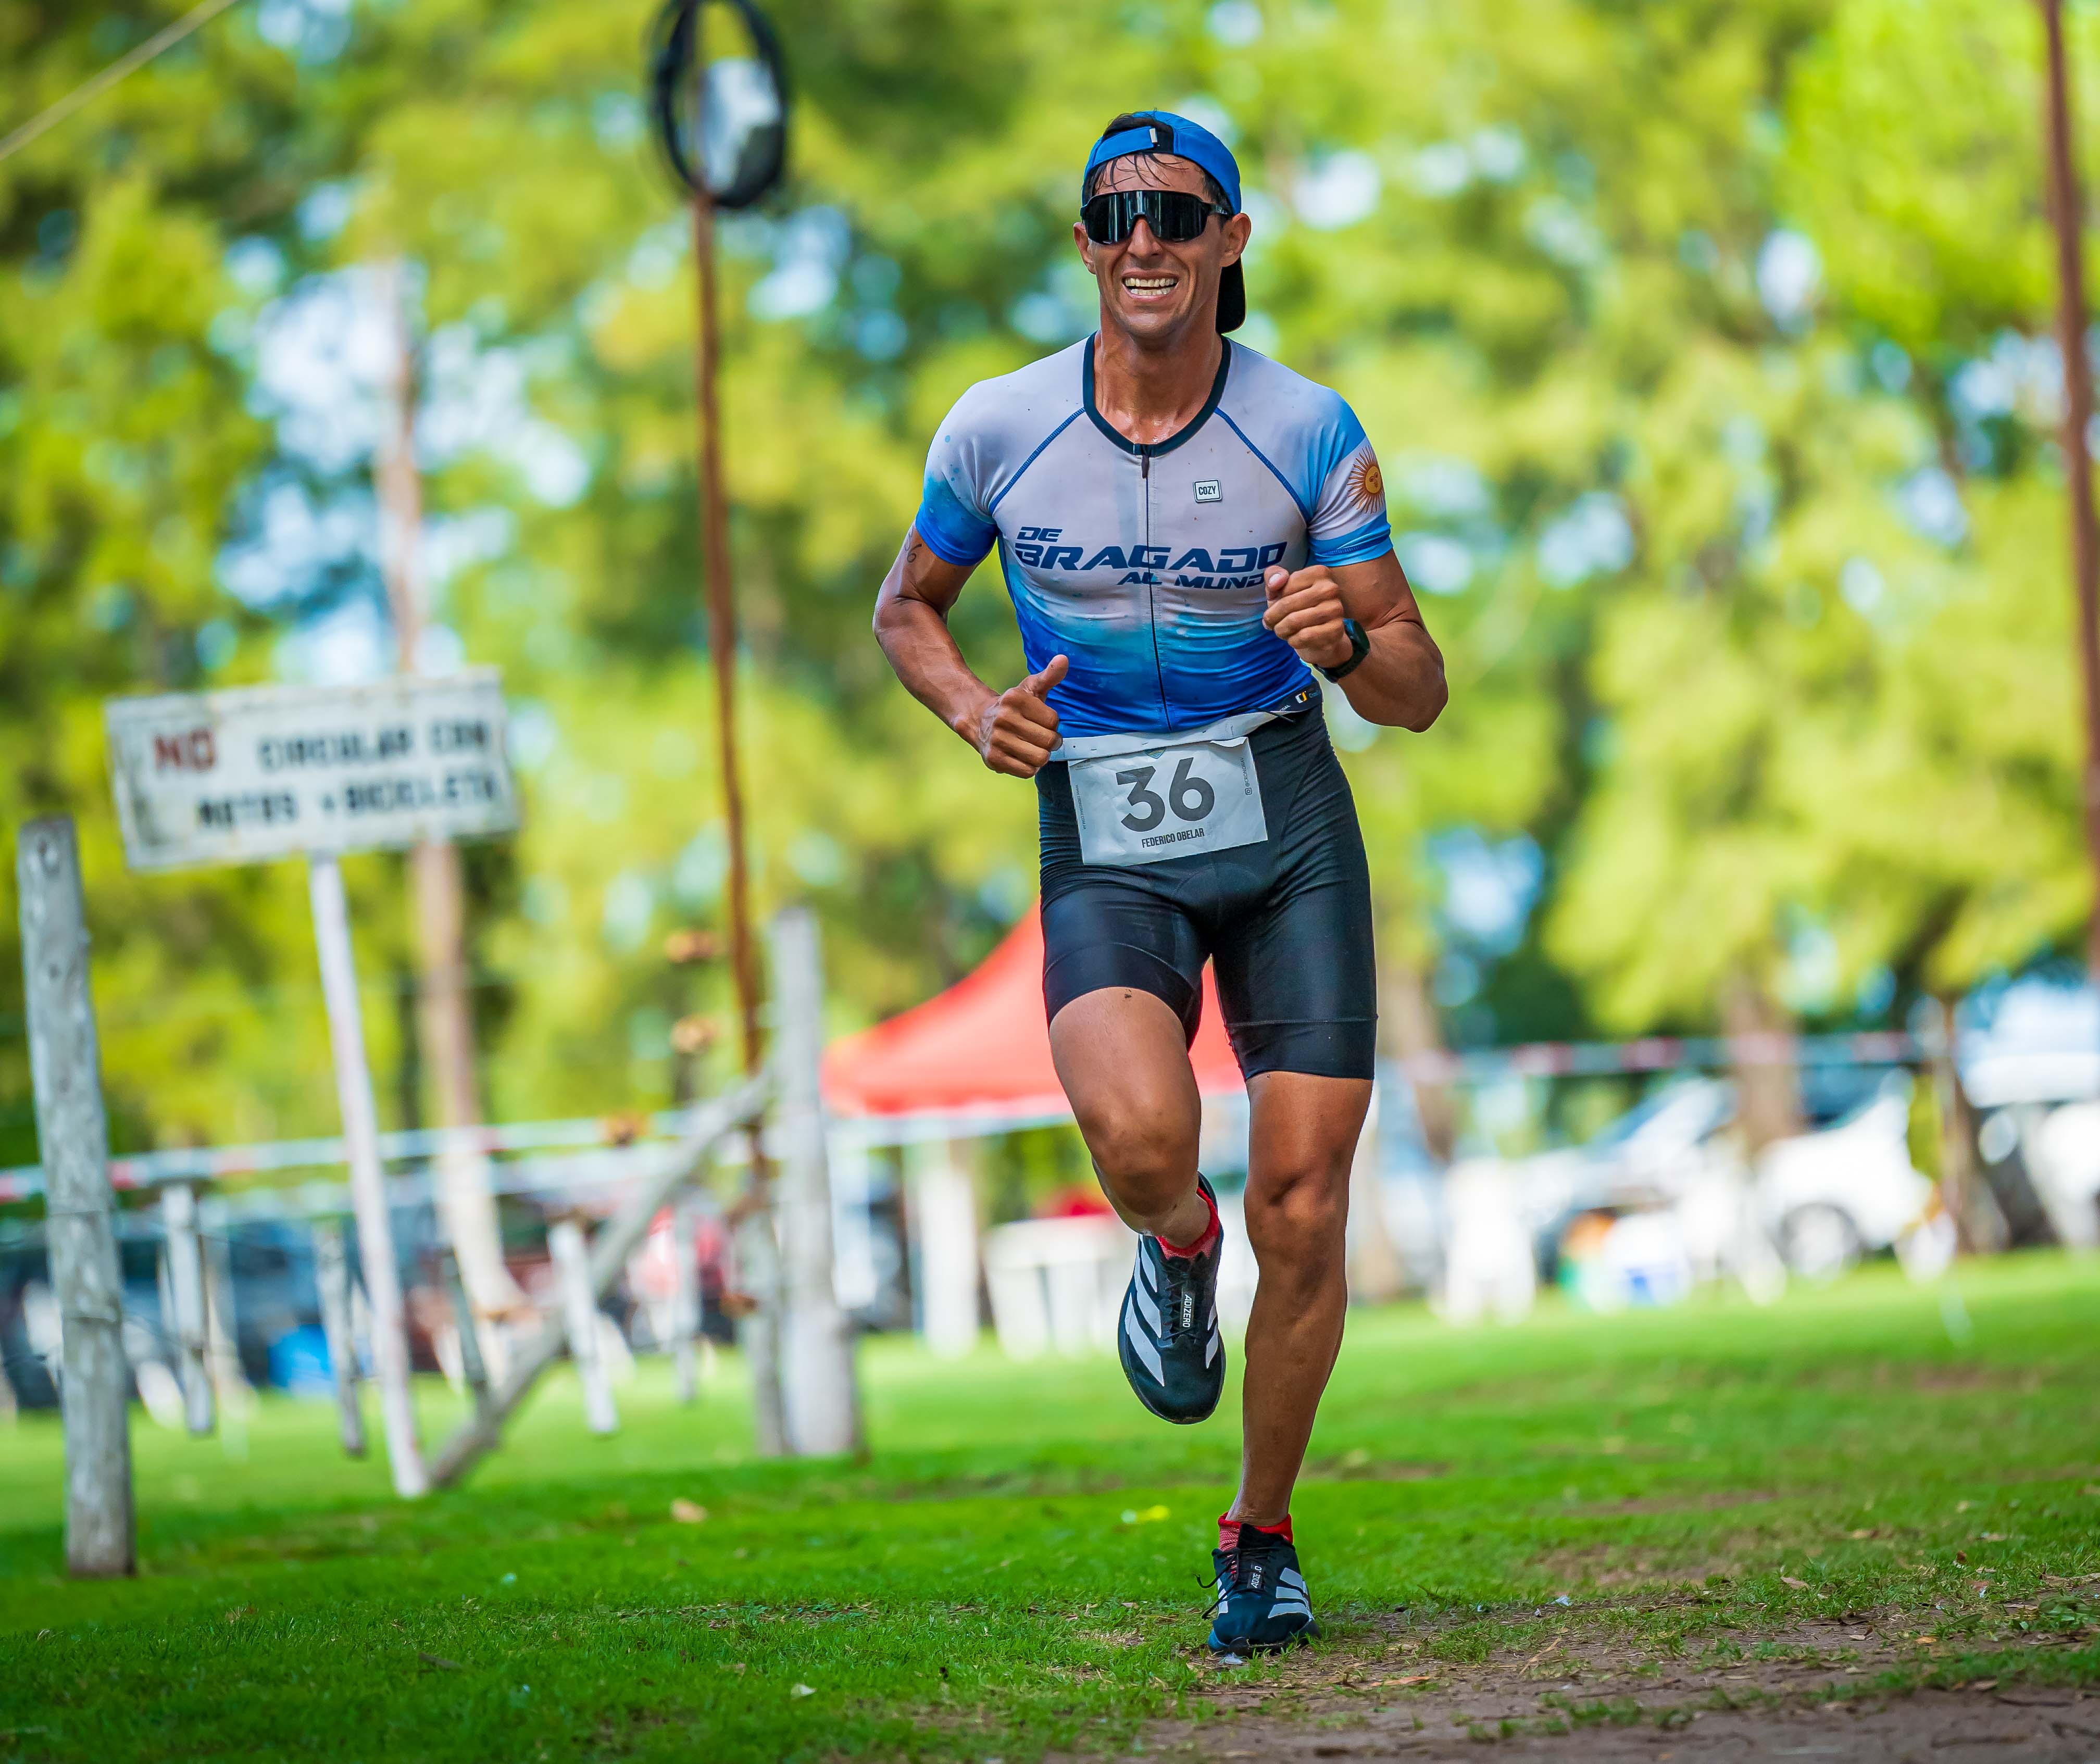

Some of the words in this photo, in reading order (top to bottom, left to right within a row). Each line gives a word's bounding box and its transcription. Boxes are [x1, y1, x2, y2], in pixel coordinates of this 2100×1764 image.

[1198, 485, 1216, 495] COZY
[1017, 526, 1062, 542] DE
[1015, 542, 1288, 572] BRAGADO
[1117, 572, 1162, 585] AL
[1174, 573, 1265, 590] MUND
[154, 730, 217, 770] NO
[1239, 757, 1251, 787] @CRONORAV
[1116, 757, 1215, 832] 36
[1141, 833, 1176, 848] FEDERICO
[1177, 828, 1205, 842] OBELAR
[1183, 1294, 1192, 1328] ADIZERO
[1251, 1566, 1262, 1588] ADIZEO
